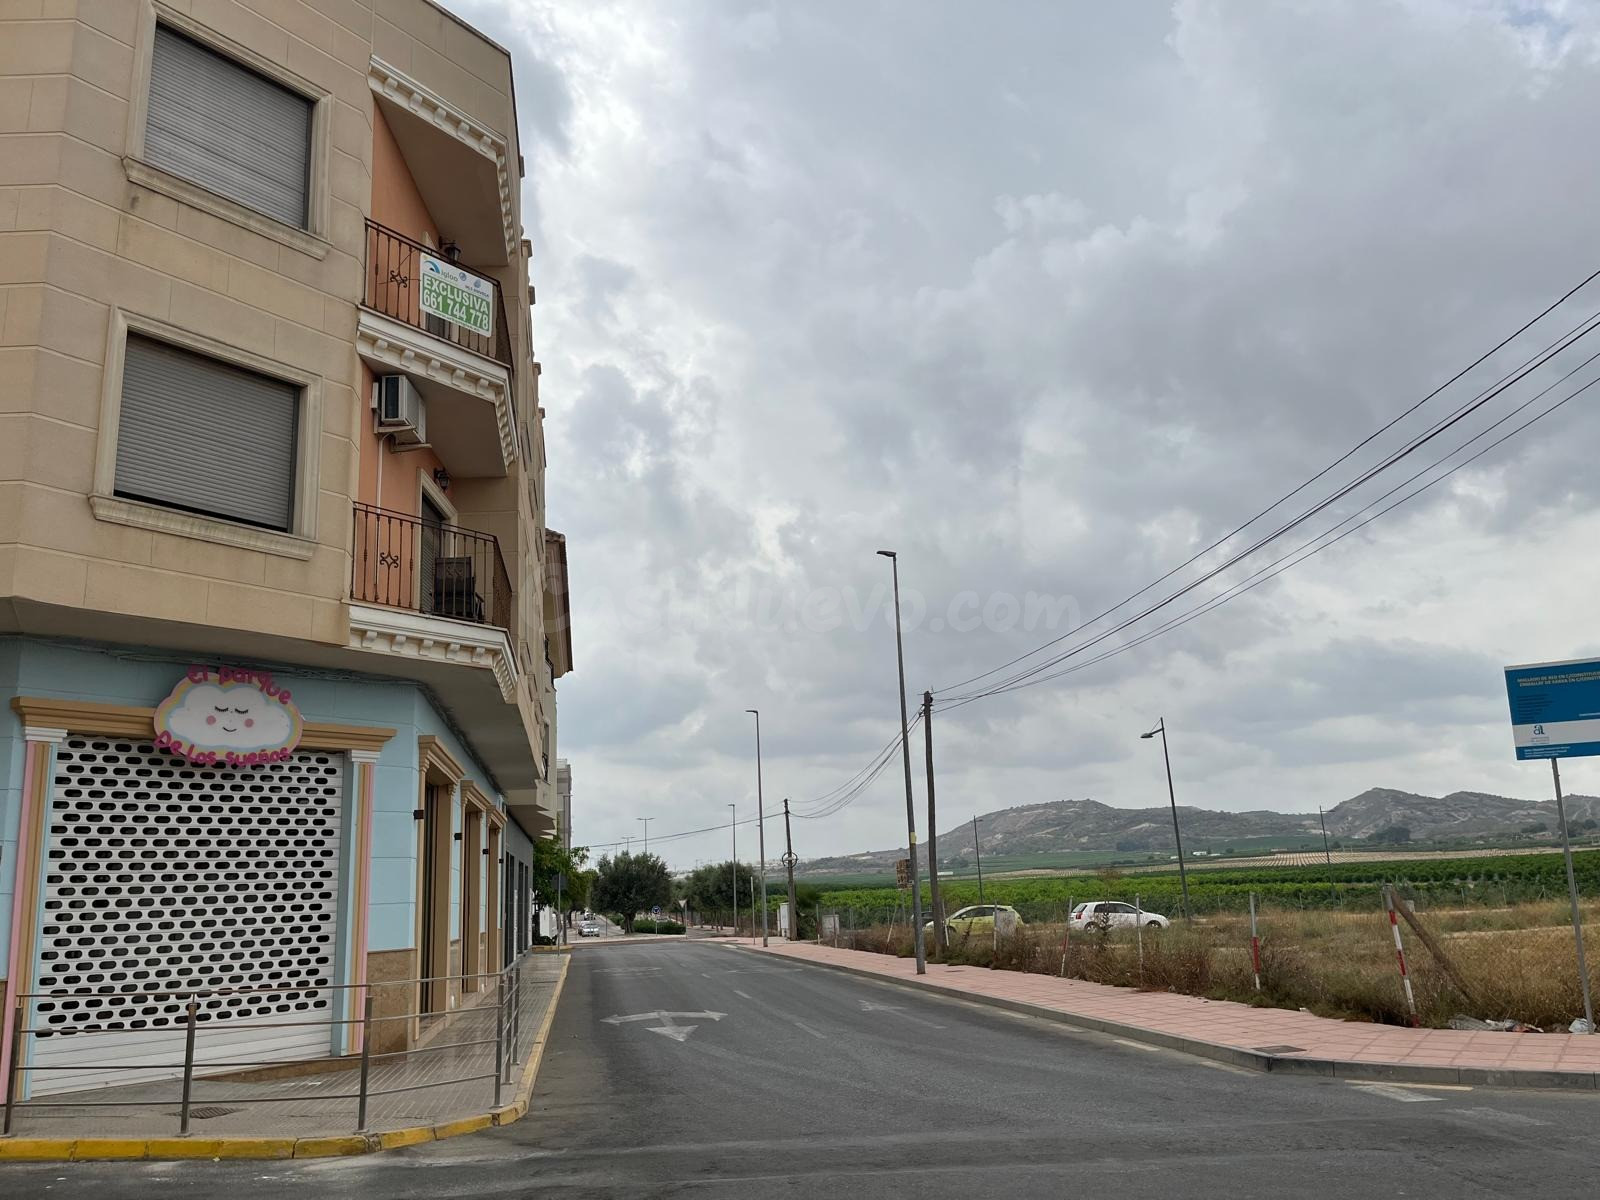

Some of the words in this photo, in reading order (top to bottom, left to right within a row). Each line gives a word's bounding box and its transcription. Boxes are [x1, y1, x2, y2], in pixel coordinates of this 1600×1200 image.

[423, 289, 443, 312] 661
[447, 299, 467, 321] 744
[469, 309, 489, 330] 778
[424, 275, 489, 314] EXCLUSIVA
[218, 665, 292, 705] parque
